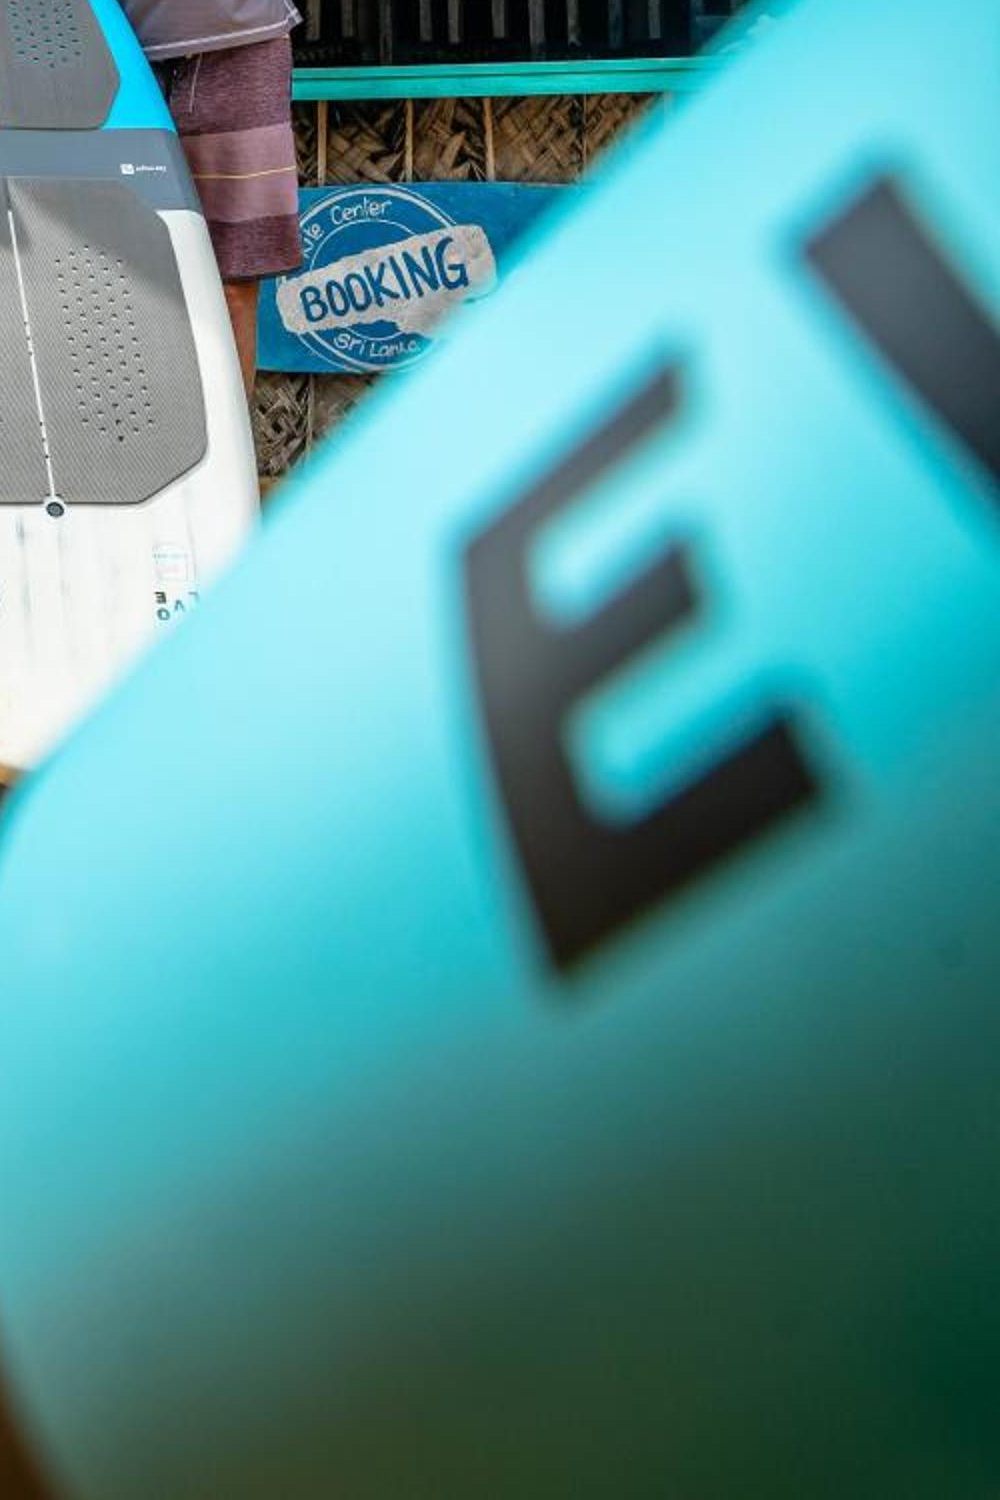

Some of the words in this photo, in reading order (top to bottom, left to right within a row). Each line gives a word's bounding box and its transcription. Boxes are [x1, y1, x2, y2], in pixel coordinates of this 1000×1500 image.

[331, 196, 392, 225] Center
[300, 237, 469, 323] BOOKING
[333, 333, 366, 355] Sri
